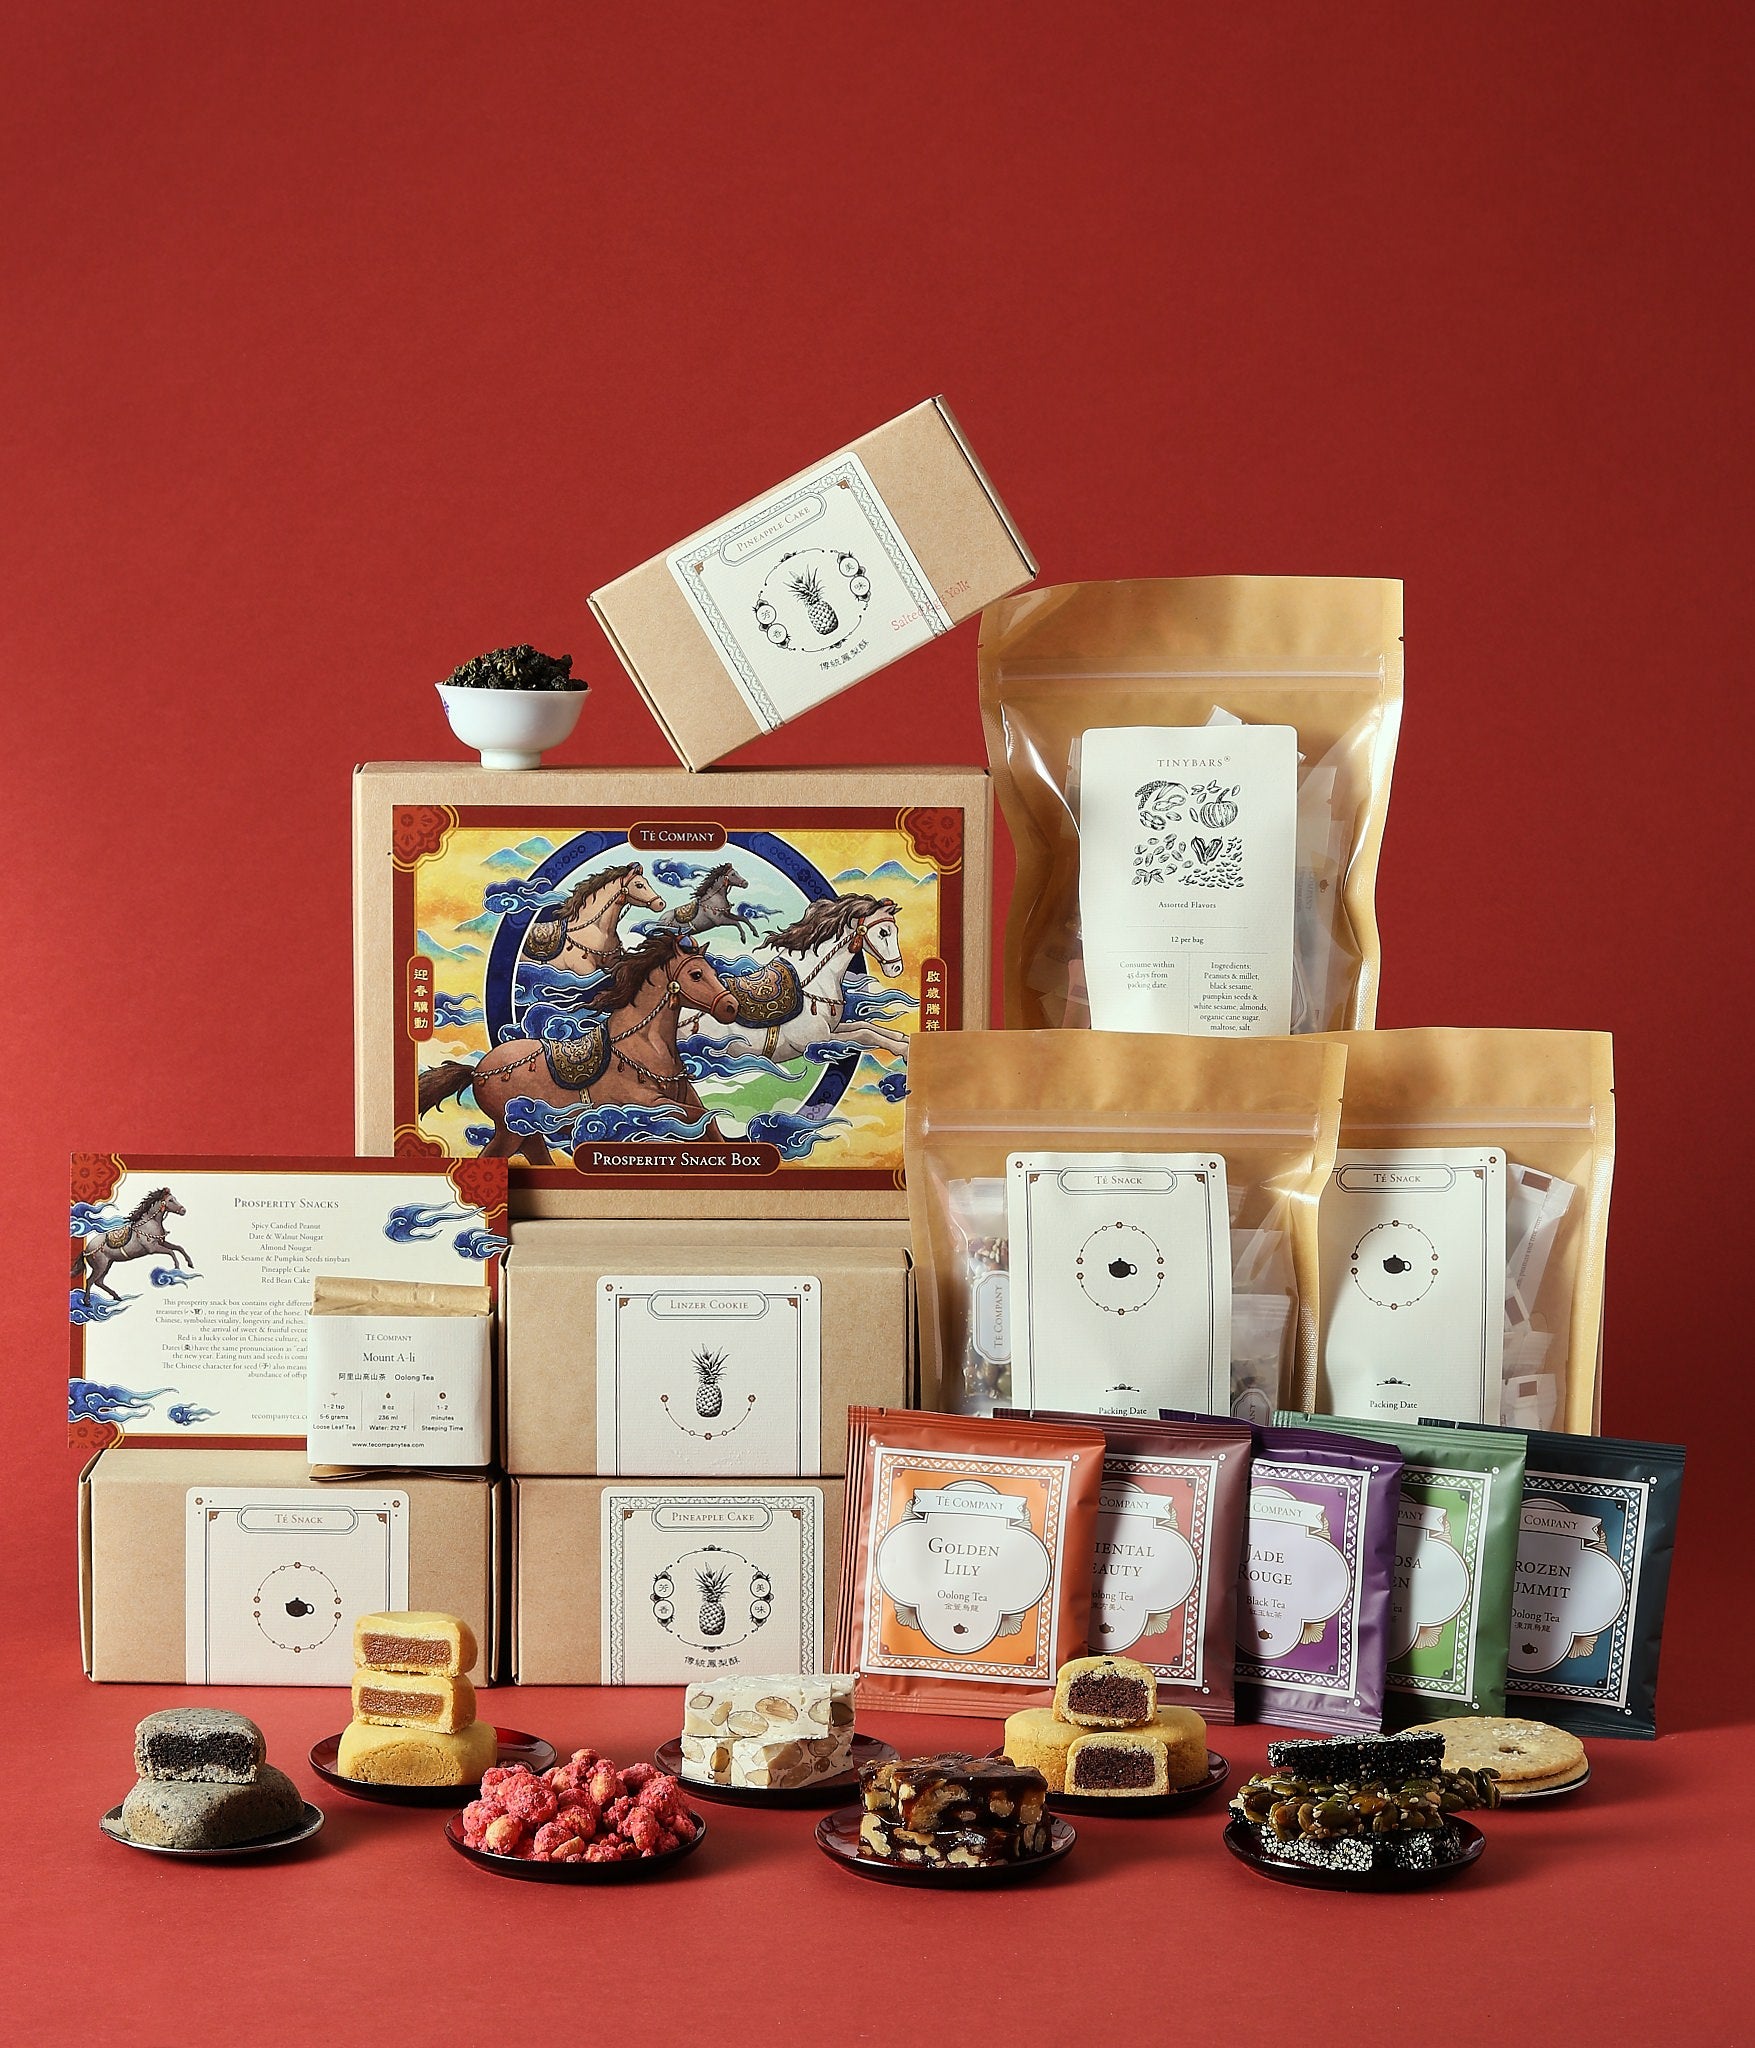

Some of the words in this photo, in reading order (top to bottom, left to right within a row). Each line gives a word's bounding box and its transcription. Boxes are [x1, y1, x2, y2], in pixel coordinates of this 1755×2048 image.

[891, 610, 924, 631] Salted
[925, 595, 948, 612] Egg
[945, 580, 970, 598] Yolk
[658, 830, 715, 842] COMPANY
[1158, 901, 1189, 909] Assorted
[1191, 901, 1217, 909] Flavors
[1180, 937, 1191, 945] per
[1192, 936, 1204, 945] bag
[1120, 961, 1152, 969] Consume
[1152, 960, 1175, 969] within
[1127, 972, 1134, 980] 45
[1135, 971, 1150, 980] days
[1151, 971, 1168, 979] from
[1204, 972, 1230, 980] Peanuts
[1239, 972, 1260, 981] millet,
[1127, 981, 1151, 990] packing
[1210, 981, 1227, 990] black
[1228, 983, 1253, 991] sesame,
[1202, 993, 1232, 1002] pumpkin
[1193, 1002, 1212, 1010] white
[1239, 1003, 1269, 1012] almonds,
[1200, 1013, 1225, 1022] organic
[1241, 1014, 1260, 1022] sugar,
[1210, 1023, 1237, 1031] maltose,
[593, 1151, 676, 1166] PROSPERITY
[680, 1152, 727, 1166] SNACK
[731, 1152, 761, 1166] BOX
[1111, 1175, 1143, 1185] SNACK
[1390, 1173, 1421, 1183] SNACK
[234, 1198, 297, 1208] PROSPERITY
[299, 1198, 339, 1209] SNACKS
[251, 1222, 268, 1230] Spicy
[270, 1222, 297, 1230] Candied
[299, 1222, 321, 1230] Peanut
[299, 1233, 323, 1242] Nougat
[288, 1244, 312, 1252] Nougat
[222, 1254, 239, 1262] Black
[274, 1255, 304, 1263] Pumpkin
[305, 1255, 323, 1263] Seeds
[324, 1256, 350, 1264] tinybars
[261, 1266, 292, 1274] Pineapple
[163, 1298, 176, 1306] This
[177, 1299, 208, 1308] prosperity
[269, 1300, 285, 1308] eight
[286, 1299, 312, 1307] different
[670, 1299, 706, 1309] LINZER
[709, 1299, 749, 1309] COOKIE
[363, 1352, 394, 1362] Mount
[395, 1374, 420, 1382] Oolong
[1370, 1400, 1399, 1410] Packing
[1400, 1401, 1418, 1409] Date
[1098, 1407, 1128, 1416] Packing
[1129, 1407, 1147, 1415] Date
[952, 1497, 1005, 1510] COMPANY
[1098, 1496, 1150, 1510] COMPANY
[1253, 1502, 1303, 1518] COMPANY
[291, 1514, 323, 1524] SNACK
[672, 1512, 724, 1522] PINEAPPLE
[727, 1512, 755, 1522] CAKE
[1524, 1515, 1578, 1530] COMPANY
[928, 1537, 1000, 1557] GOLDEN
[944, 1559, 981, 1576] LILY
[1515, 1561, 1572, 1578] ROZEN
[1513, 1582, 1571, 1599] UMMIT
[937, 1590, 970, 1602] Oolong
[972, 1592, 988, 1601] Tea
[1092, 1590, 1116, 1602] olong
[1119, 1592, 1134, 1601] Tea
[1247, 1595, 1268, 1607] Black
[1271, 1598, 1286, 1609] Tea
[1544, 1612, 1560, 1623] Tea
